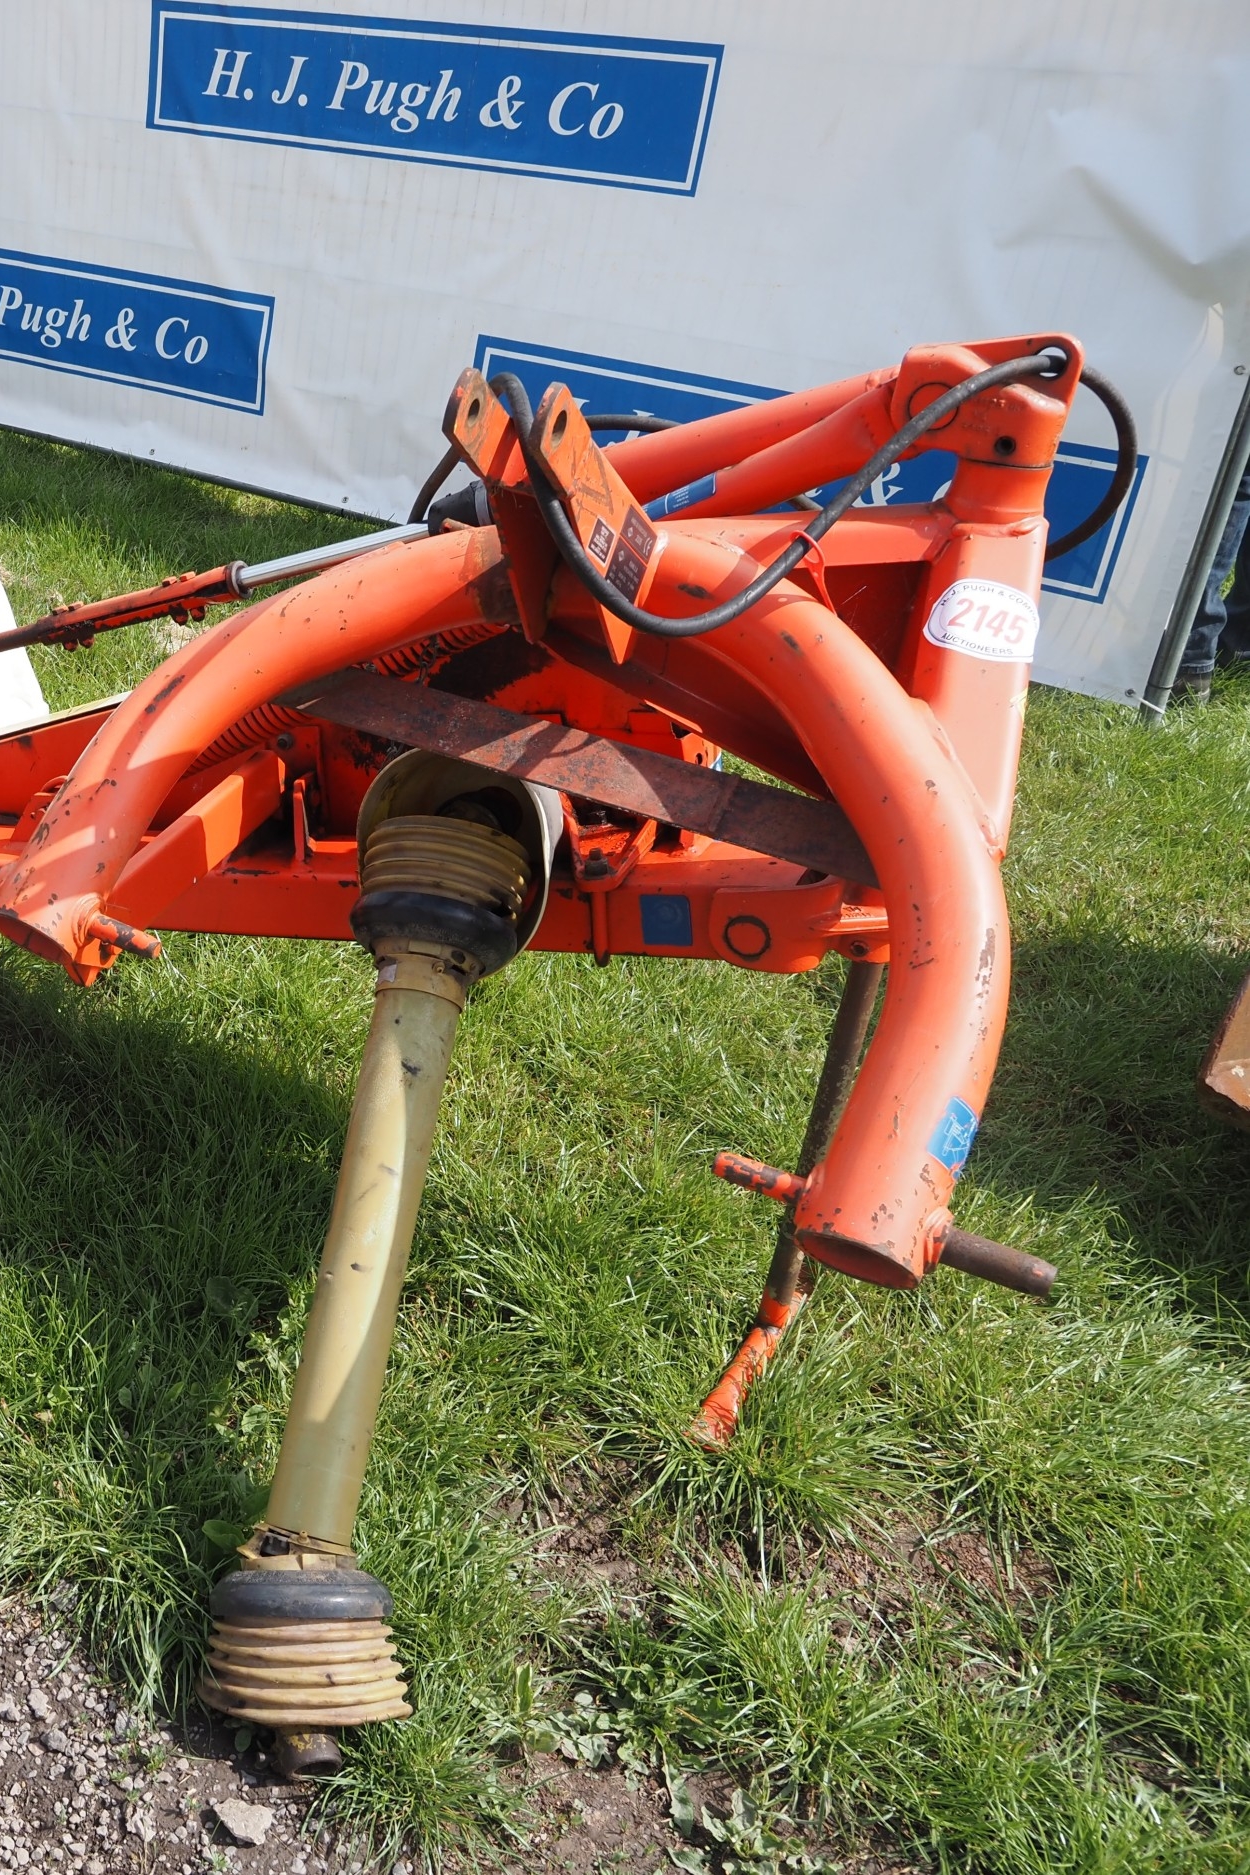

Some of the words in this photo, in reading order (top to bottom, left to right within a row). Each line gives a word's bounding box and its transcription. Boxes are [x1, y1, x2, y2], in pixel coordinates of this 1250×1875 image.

[202, 48, 254, 101] H.
[271, 56, 309, 107] J.
[325, 60, 463, 133] Pugh
[479, 75, 526, 130] &
[548, 81, 625, 139] Co
[104, 307, 138, 352] &
[155, 317, 209, 365] Co
[963, 585, 995, 593] PUGH
[941, 632, 1014, 655] AUCTIONEERS
[947, 598, 1029, 644] 2145
